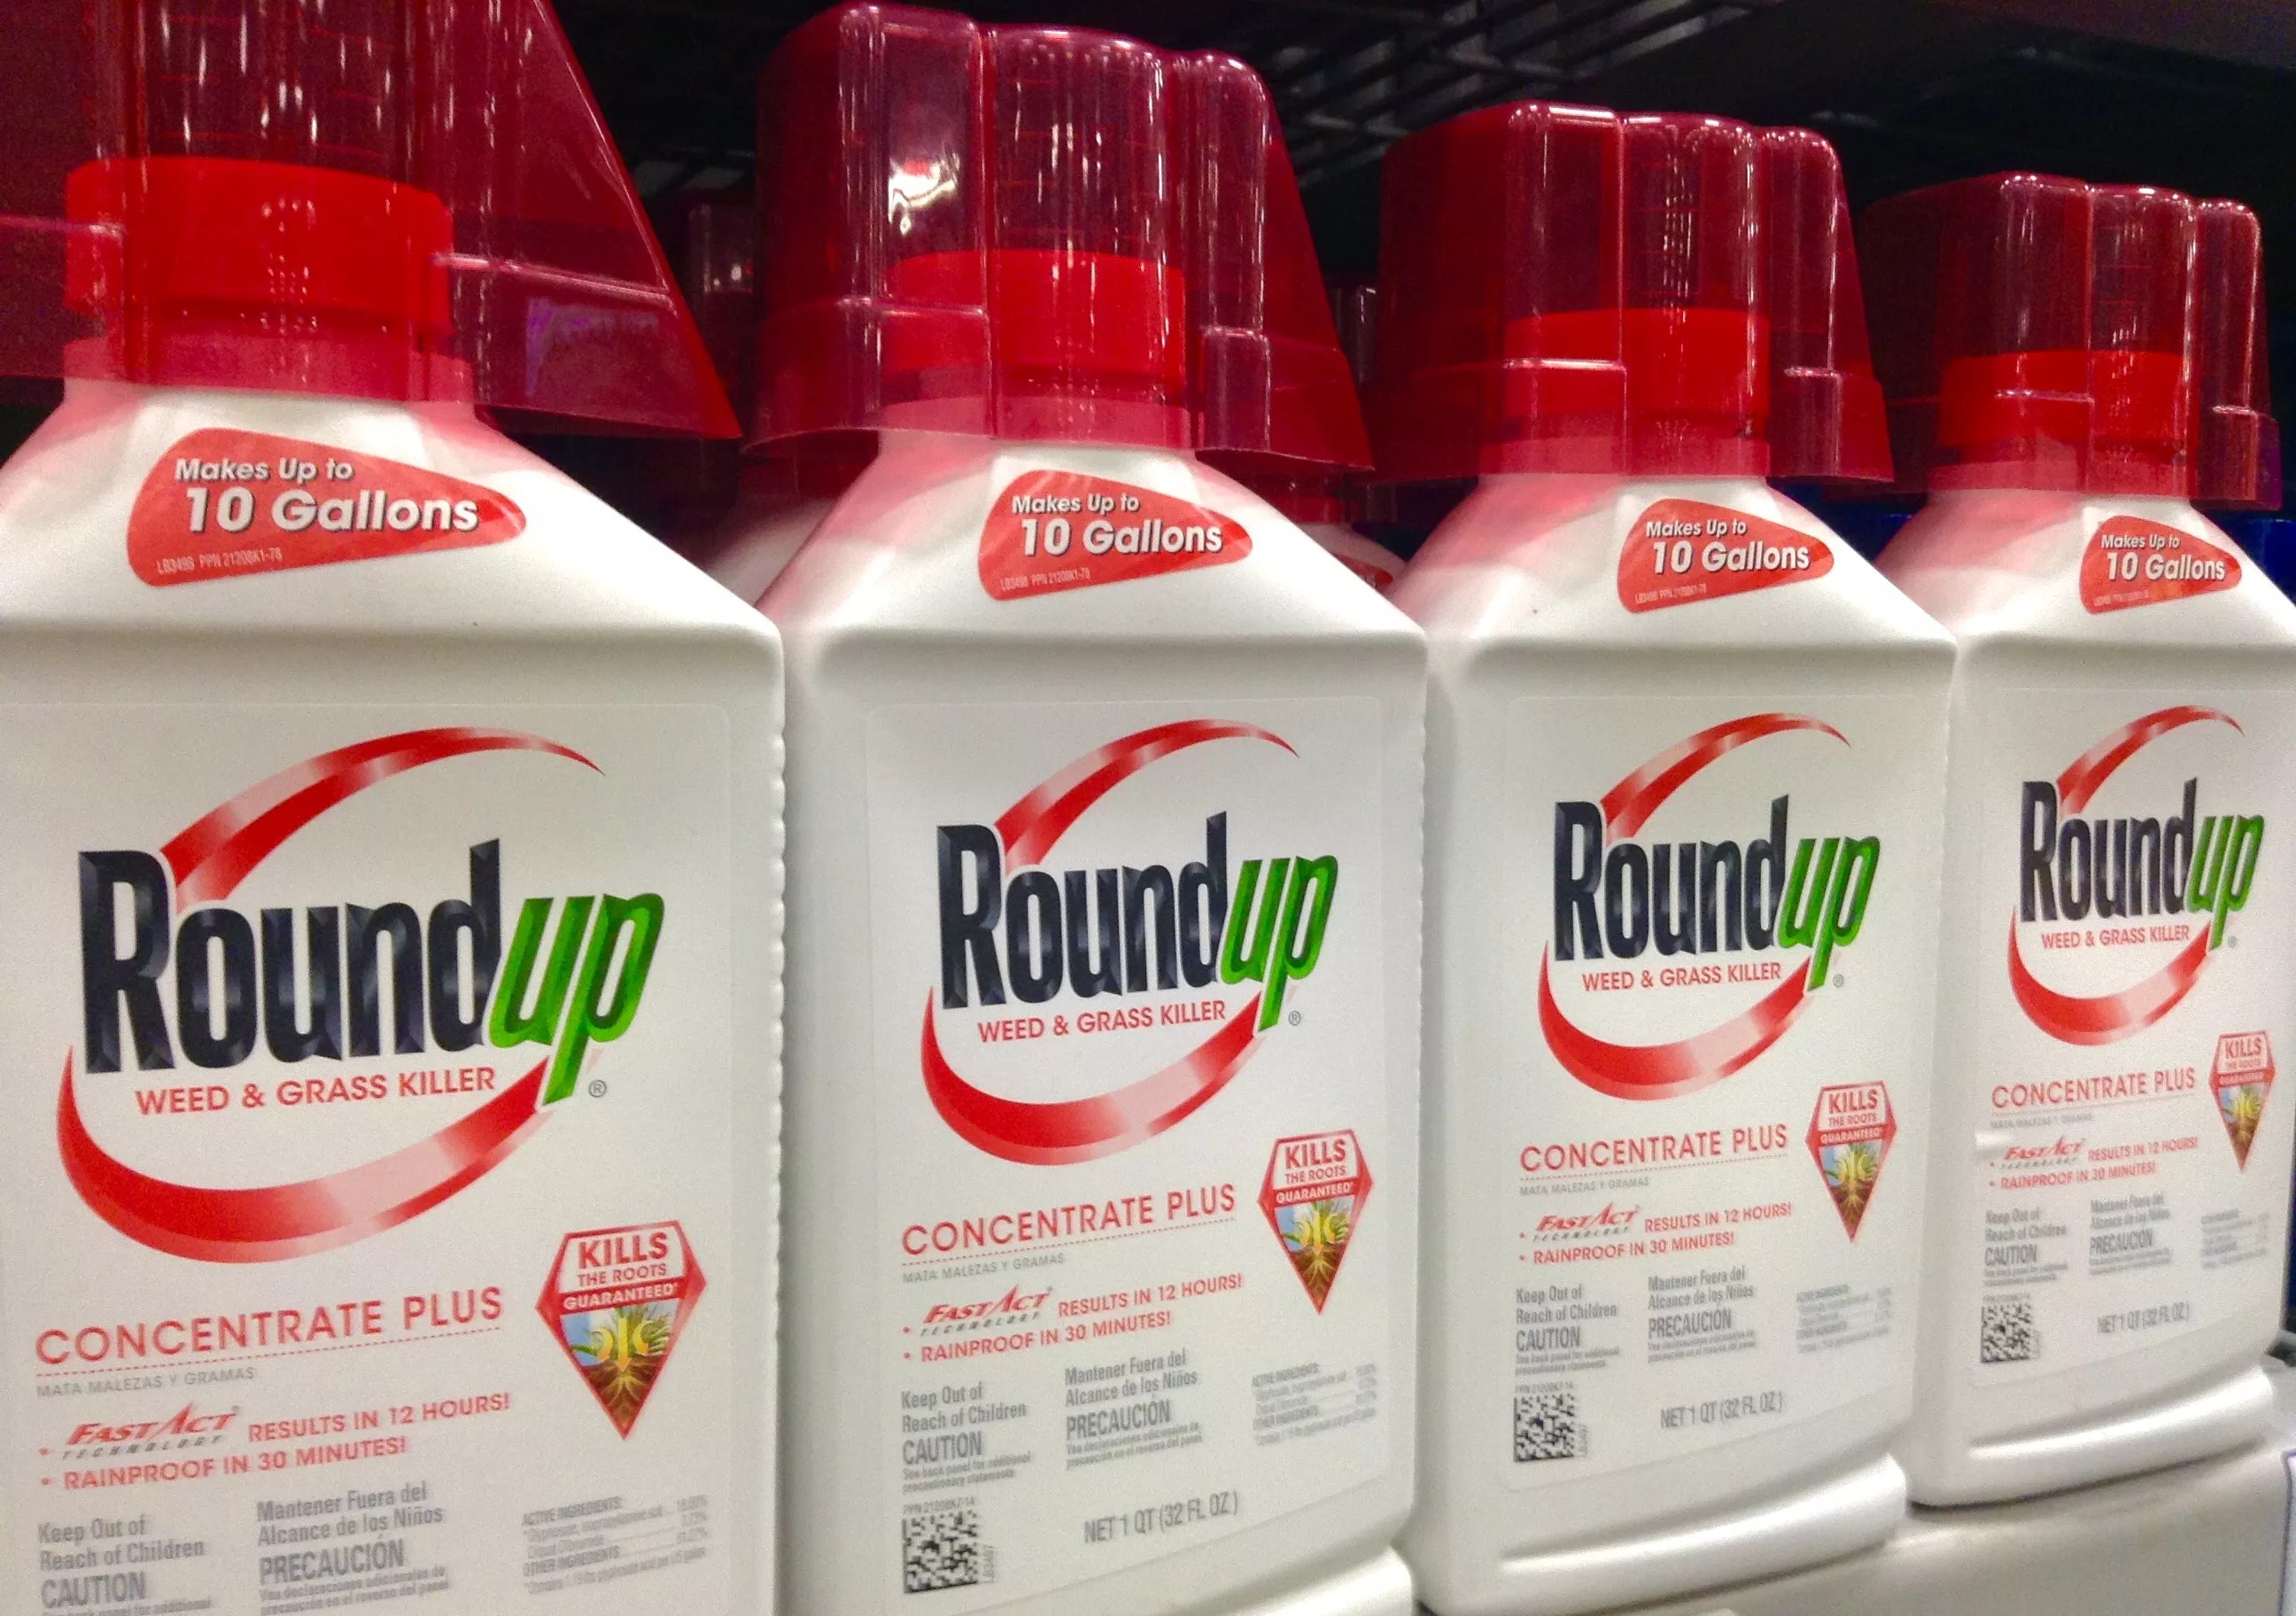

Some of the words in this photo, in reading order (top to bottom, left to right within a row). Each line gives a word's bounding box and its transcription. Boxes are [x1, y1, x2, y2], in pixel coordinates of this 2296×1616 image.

[176, 458, 268, 481] Makes
[278, 458, 318, 486] Up
[326, 457, 354, 480] to
[185, 486, 255, 533] 10
[271, 489, 479, 533] Gallons
[1012, 495, 1082, 515] Makes
[1087, 493, 1116, 516] Up
[1120, 493, 1141, 513] to
[1020, 517, 1072, 556] 10
[1082, 518, 1223, 556] Gallons
[1645, 521, 1702, 538] Makes
[1706, 518, 1727, 538] Up
[1732, 518, 1747, 536] to
[2101, 534, 2145, 548] Makes
[2149, 534, 2166, 551] Up
[2168, 534, 2180, 548] to
[1653, 540, 1694, 575] 10
[1702, 540, 1811, 572] Gallons
[2106, 551, 2138, 581] 10
[2145, 554, 2226, 581] Gallons
[2020, 777, 2265, 950] Roundup
[1555, 795, 1881, 991] Roundup
[936, 811, 1338, 1032] Roundup
[2041, 931, 2081, 950] WEED
[2085, 930, 2095, 946] &
[2099, 928, 2146, 946] GRASS
[2150, 924, 2191, 942] KILLER
[78, 838, 664, 1105] Roundup
[1581, 971, 1634, 992] WEED
[1641, 970, 1654, 989] &
[1660, 966, 1722, 988] GRASS
[1727, 961, 1781, 984] KILLER
[977, 1018, 1045, 1044] WEED
[1053, 1015, 1069, 1036] &
[1076, 1007, 1153, 1033] GRASS
[1160, 999, 1226, 1026] KILLER
[2225, 1037, 2261, 1060] KILLS
[135, 1084, 231, 1115] WEED
[242, 1083, 266, 1108] &
[275, 1074, 387, 1106] GRASS
[398, 1066, 496, 1097] KILLER
[1828, 1088, 1878, 1115] KILLS
[1991, 1072, 2147, 1108] CONCENTRATE
[2154, 1067, 2197, 1092] PLUS
[1284, 1138, 1346, 1169] KILLS
[1519, 1130, 1722, 1173] CONCENTRATE
[1732, 1123, 1788, 1154] PLUS
[1284, 1171, 1306, 1185] THE
[1307, 1164, 1346, 1181] ROOTS
[901, 1195, 1153, 1256] CONCENTRATE
[1167, 1183, 1236, 1220] PLUS
[1644, 1214, 1701, 1234] RESULTS
[1704, 1211, 1719, 1226] IN
[1724, 1208, 1739, 1224] 12
[1742, 1201, 1793, 1222] HOURS!
[577, 1231, 669, 1270] KILLS
[1533, 1243, 1625, 1265] RAINPROOF
[1629, 1241, 1645, 1256] IN
[1649, 1239, 1667, 1254] 30
[1671, 1231, 1735, 1251] MINUTES!
[578, 1270, 608, 1287] THE
[611, 1262, 668, 1285] ROOTS
[902, 1270, 939, 1285] MATA
[942, 1262, 999, 1279] MALEZAS
[1002, 1262, 1009, 1272] Y
[1012, 1253, 1065, 1270] GRAMAS
[1058, 1294, 1129, 1319] RESULTS
[1134, 1287, 1152, 1307] IN
[1158, 1285, 1175, 1303] 12
[1181, 1273, 1243, 1298] HOURS!
[1516, 1288, 1545, 1305] Keep
[1549, 1286, 1568, 1301] Out
[1571, 1283, 1583, 1300] of
[35, 1299, 383, 1366] CONCENTRATE
[402, 1286, 505, 1329] PLUS
[1516, 1308, 1551, 1325] Reach
[1555, 1305, 1567, 1321] of
[1570, 1301, 1617, 1318] Children
[1648, 1304, 1732, 1340] PRECAUCIÓN
[921, 1332, 1035, 1364] RAINPROOF
[1040, 1327, 1059, 1346] IN
[1065, 1324, 1086, 1342] 30
[1092, 1310, 1172, 1338] MINUTES!
[1516, 1325, 1581, 1352] CAUTION
[36, 1383, 82, 1398] MATA
[89, 1374, 163, 1395] MALEZAS
[169, 1374, 178, 1387] Y
[183, 1366, 256, 1387] GRAMAS
[1065, 1365, 1126, 1387] Mantener
[1130, 1354, 1163, 1373] Fuera
[1167, 1348, 1186, 1367] del
[901, 1390, 938, 1410] Keep
[942, 1385, 966, 1404] Out
[969, 1381, 983, 1401] of
[1065, 1386, 1118, 1408] Alcance
[1121, 1379, 1136, 1397] de
[1140, 1375, 1160, 1395] los
[1162, 1370, 1198, 1391] Niños
[248, 1413, 346, 1444] RESULTS
[353, 1410, 380, 1432] IN
[389, 1404, 415, 1426] 12
[421, 1392, 512, 1422] HOURS!
[902, 1410, 947, 1433] Reach
[950, 1407, 966, 1427] of
[968, 1402, 1028, 1425] Children
[1066, 1396, 1171, 1441] PRECAUCIÓN
[64, 1457, 214, 1492] RAINPROOF
[222, 1455, 251, 1476] IN
[257, 1449, 287, 1472] 30
[295, 1436, 408, 1470] MINUTES!
[903, 1431, 983, 1466] CAUTION
[256, 1496, 341, 1522] Mantener
[346, 1488, 395, 1511] Fuera
[400, 1480, 429, 1503] del
[1084, 1515, 1114, 1543] NET
[1120, 1515, 1129, 1536] 1
[1133, 1507, 1153, 1534] QT
[1159, 1501, 1184, 1534] (32
[1186, 1498, 1206, 1527] FL
[1208, 1489, 1239, 1519] OZ)
[37, 1521, 85, 1546] Keep
[91, 1518, 123, 1539] Out
[127, 1514, 147, 1538] of
[257, 1520, 331, 1547] Alcance
[337, 1519, 358, 1539] de
[362, 1511, 389, 1535] los
[393, 1503, 444, 1528] Niños
[40, 1546, 97, 1573] Reach
[103, 1543, 123, 1566] of
[126, 1538, 206, 1563] Children
[259, 1535, 405, 1586] PRECAUCIÓN
[41, 1572, 147, 1610] CAUTION
